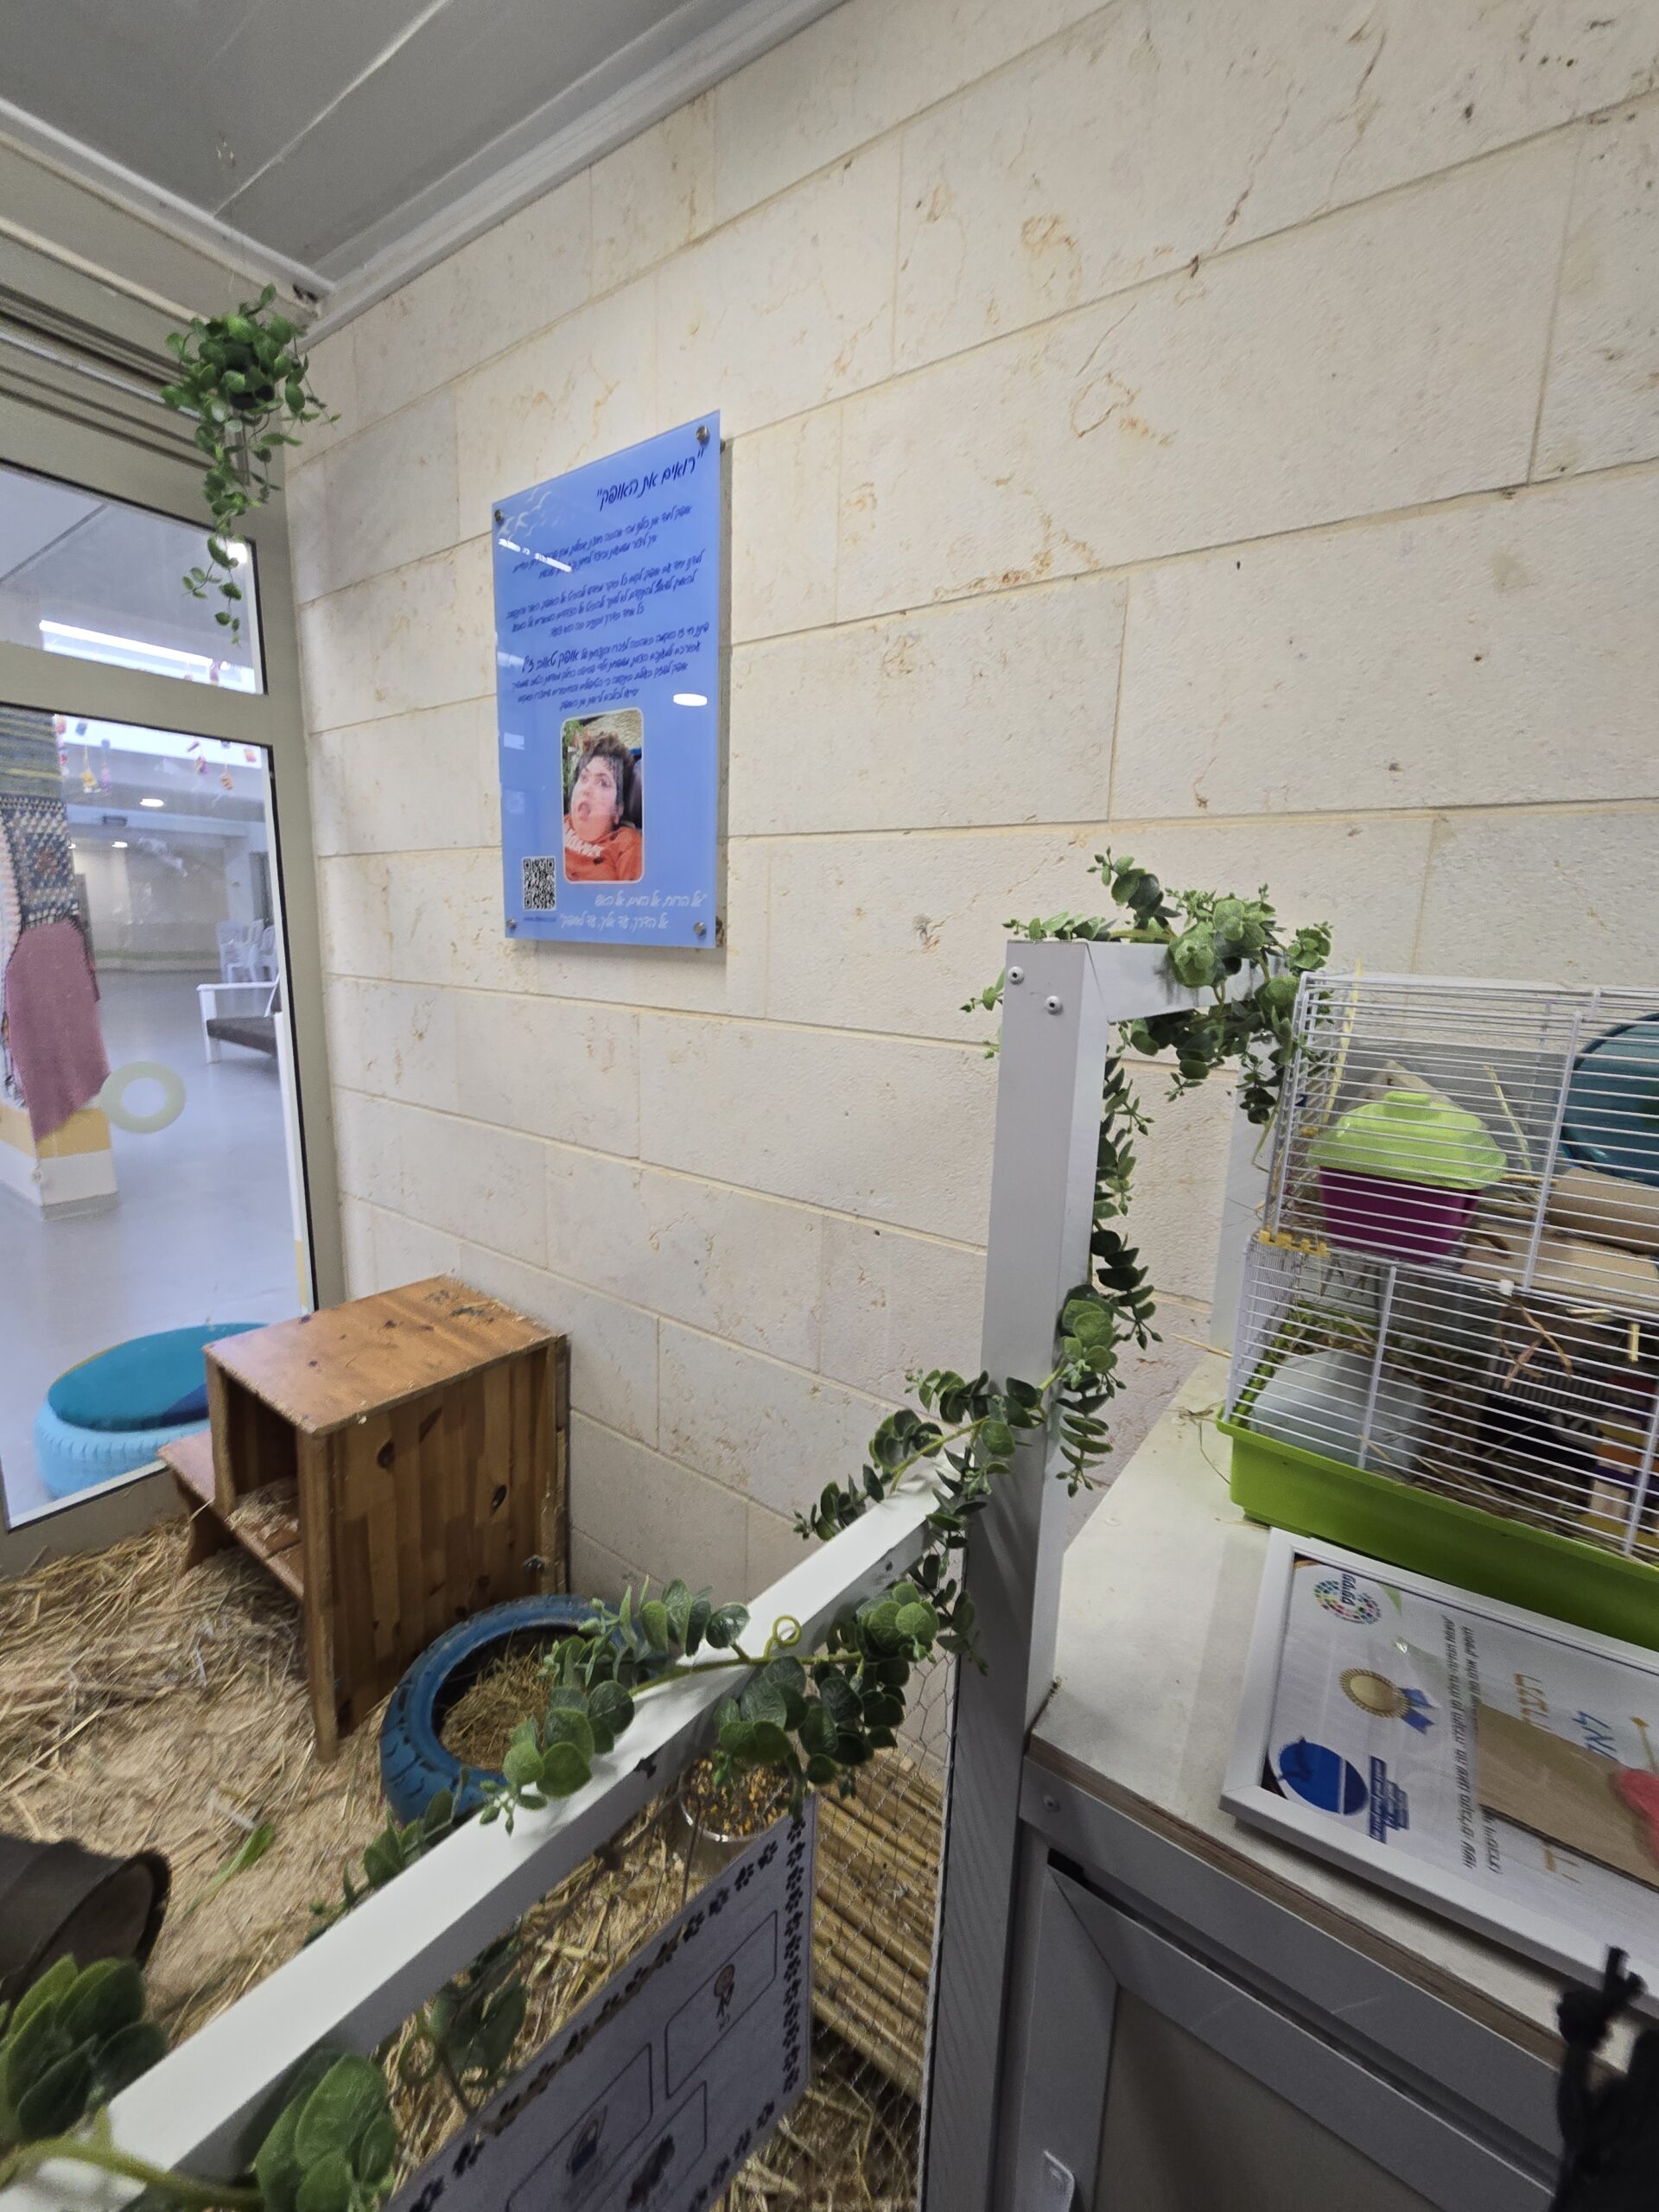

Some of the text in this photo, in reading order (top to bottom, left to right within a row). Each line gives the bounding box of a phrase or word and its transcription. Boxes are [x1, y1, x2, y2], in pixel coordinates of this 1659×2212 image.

[636, 474, 658, 498] את
[557, 650, 579, 668] אופק
[1341, 1573, 1357, 1606] פסיפס
[1455, 1749, 1467, 1765] מה
[1462, 1840, 1476, 1869] עשוי
